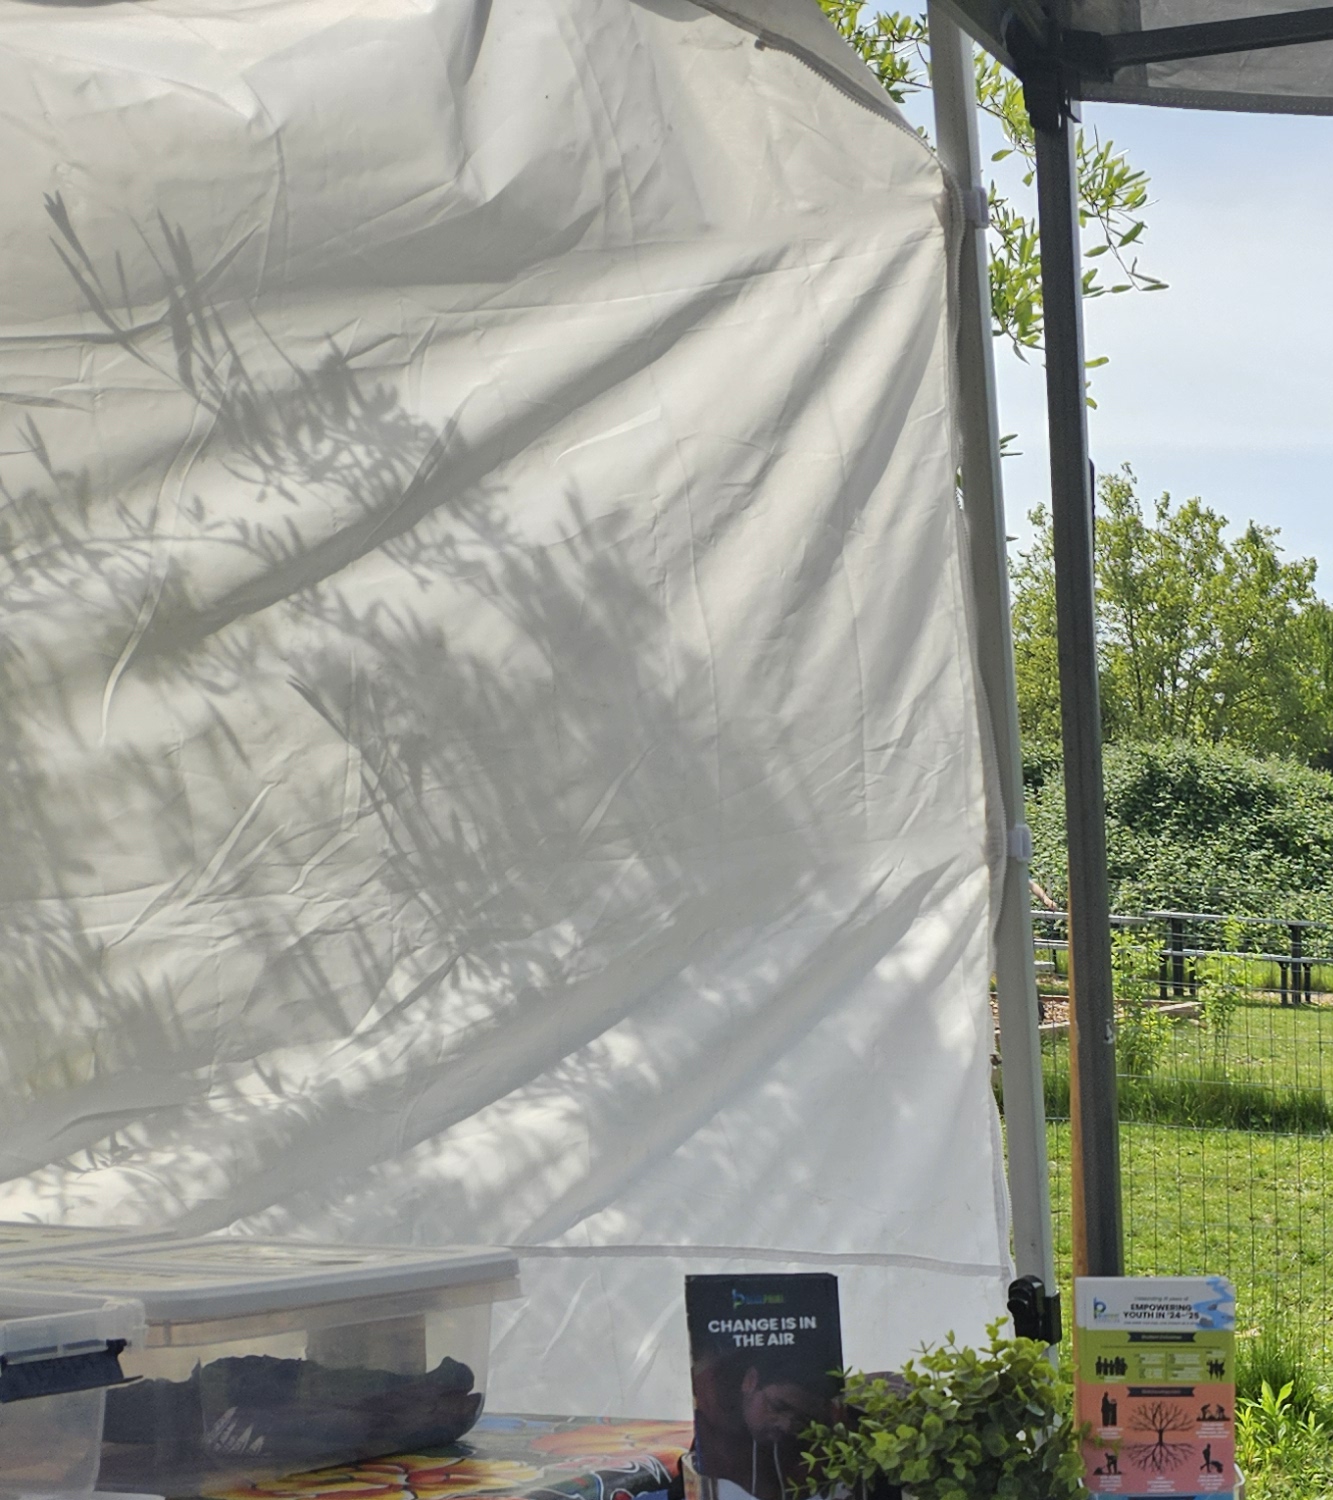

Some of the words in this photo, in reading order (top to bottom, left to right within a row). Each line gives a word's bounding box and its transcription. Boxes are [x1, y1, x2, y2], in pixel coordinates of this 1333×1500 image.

[1123, 1311, 1156, 1319] YOUTH
[708, 1318, 778, 1333] CHANGE
[782, 1317, 796, 1330] IS
[800, 1316, 817, 1329] IN
[733, 1334, 764, 1348] THE
[768, 1332, 795, 1346] AIR
